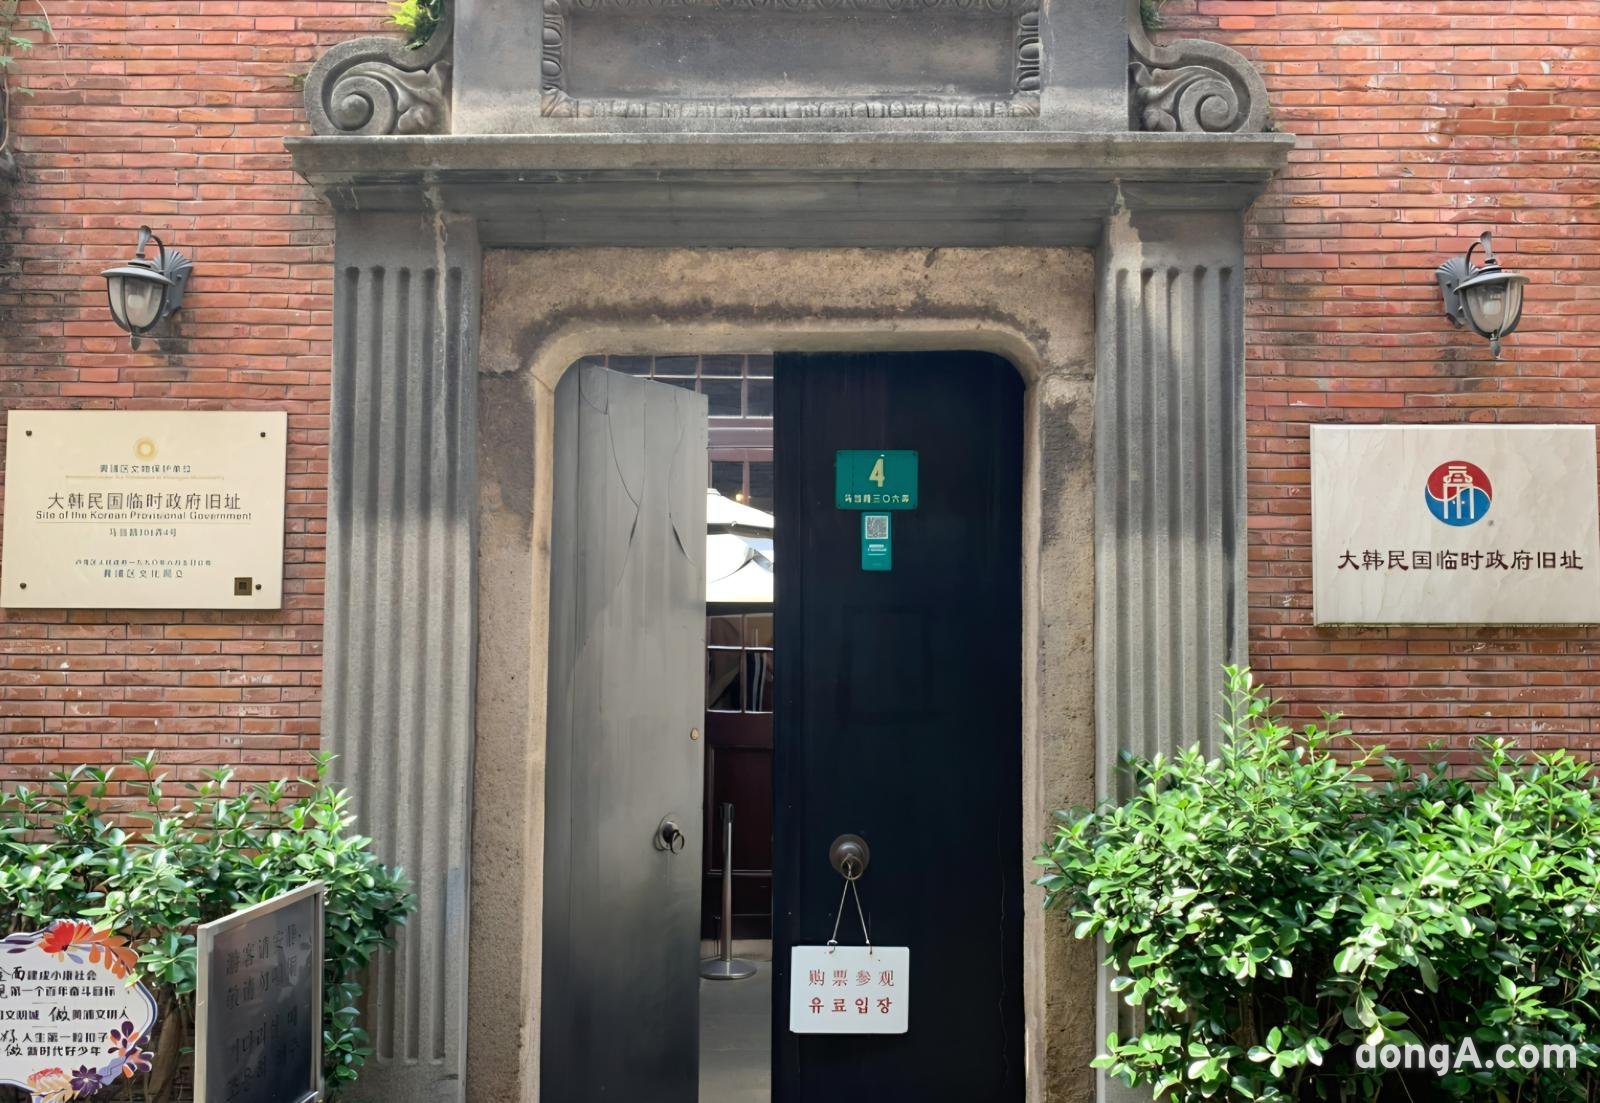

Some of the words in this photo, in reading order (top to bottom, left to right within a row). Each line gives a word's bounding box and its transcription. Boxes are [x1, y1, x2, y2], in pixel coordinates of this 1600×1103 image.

[868, 457, 886, 488] 4
[47, 492, 241, 510] 大韩民国临时政府旧址
[59, 511, 69, 520] of
[71, 511, 87, 520] the
[90, 511, 128, 520] Korean
[189, 511, 252, 520] Government
[1337, 549, 1584, 571] 大韩民国临时政府旧址
[808, 968, 895, 987] 购票参观
[0, 1008, 40, 1020] 文明城
[808, 996, 893, 1015] 유료입장
